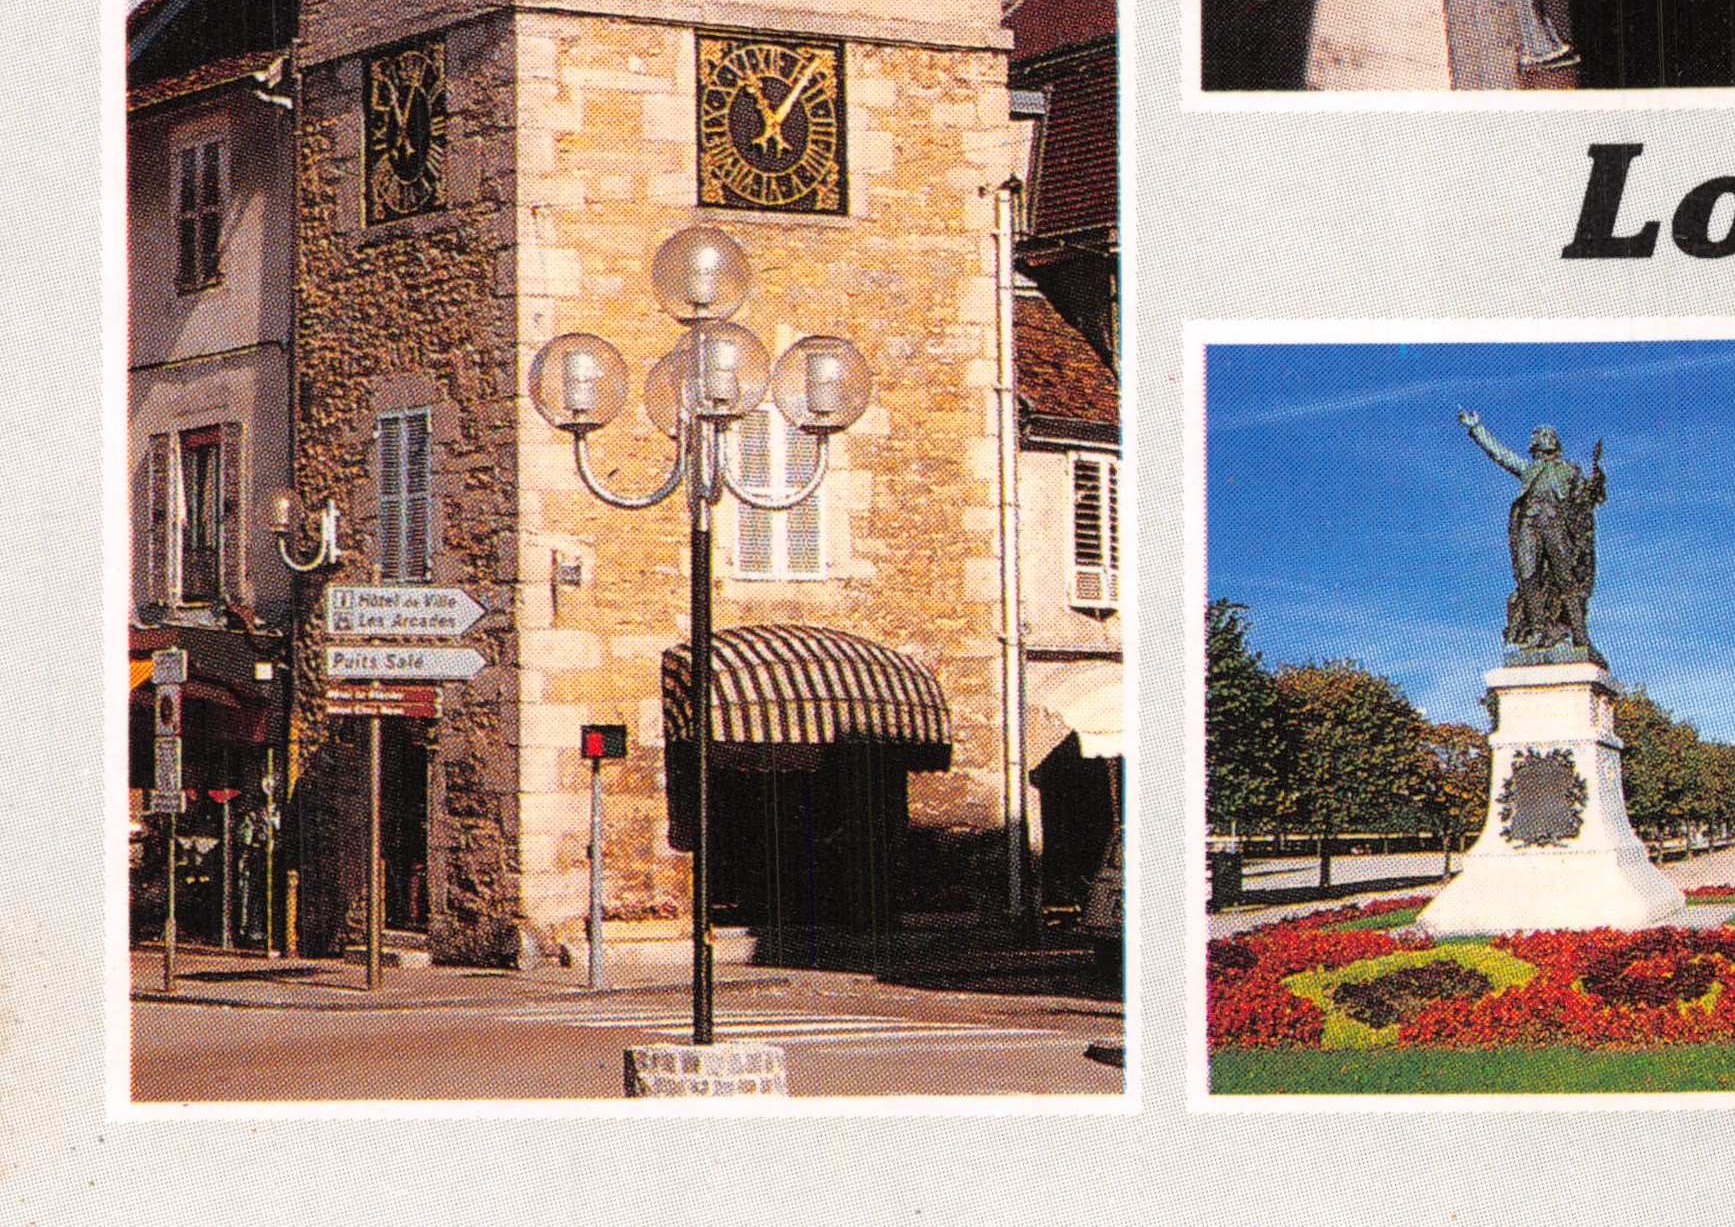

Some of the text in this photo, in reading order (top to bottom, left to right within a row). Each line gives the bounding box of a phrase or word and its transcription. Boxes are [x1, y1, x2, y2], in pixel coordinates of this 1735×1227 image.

[357, 593, 400, 608] Hôtel
[424, 593, 458, 607] Ville
[357, 612, 457, 629] Les Arcades
[332, 651, 424, 670] Puits Salé
